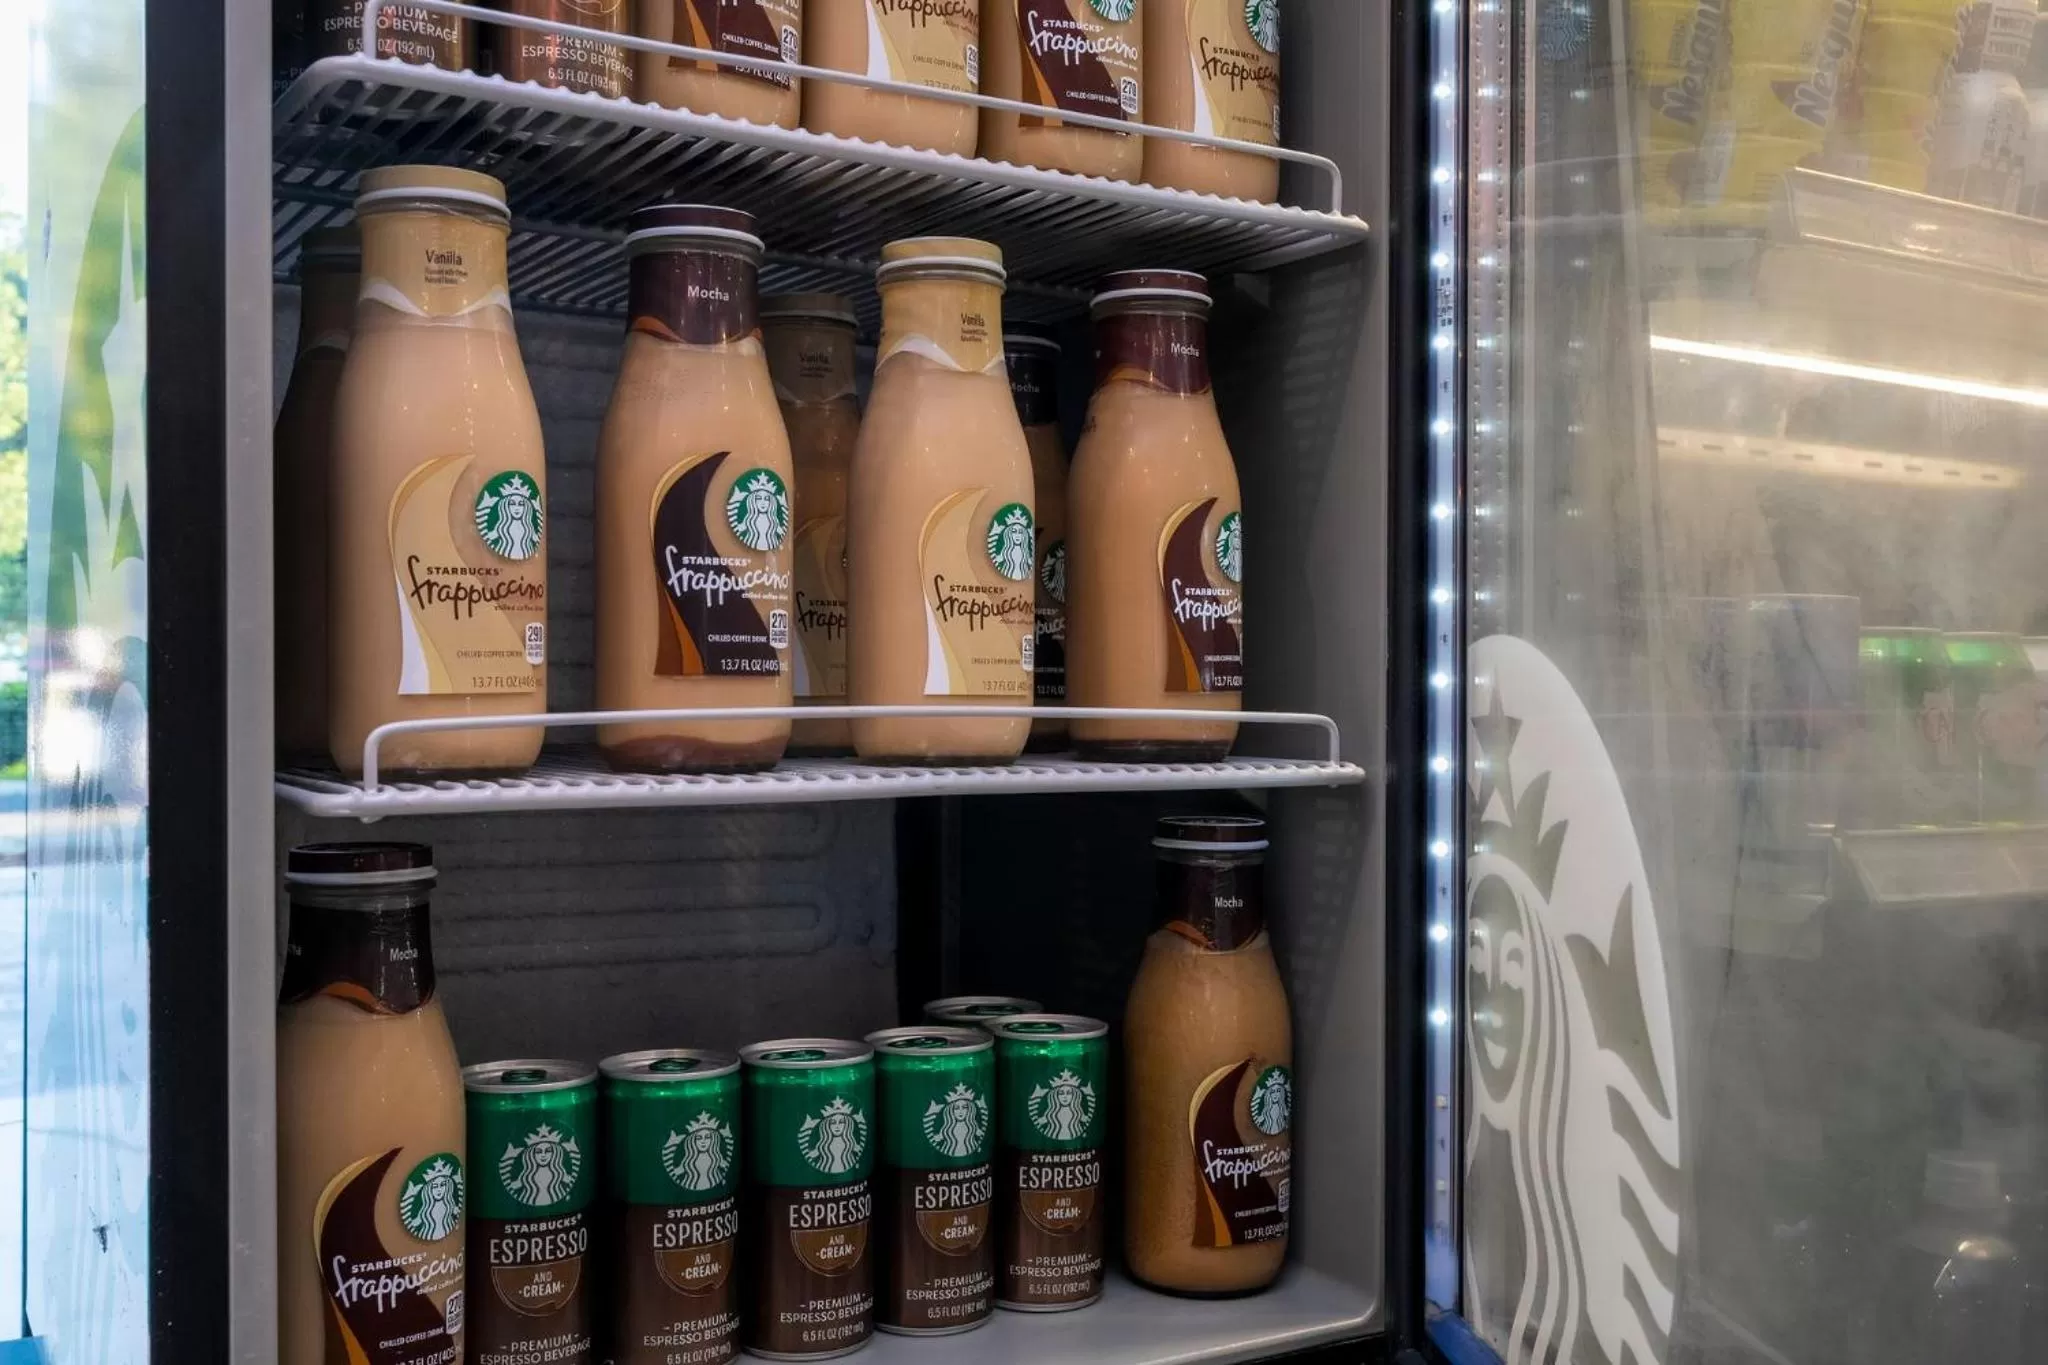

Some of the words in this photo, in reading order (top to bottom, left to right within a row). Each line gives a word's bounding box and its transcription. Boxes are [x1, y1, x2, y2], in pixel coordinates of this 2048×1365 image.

[355, 2, 428, 20] PMIUM
[325, 15, 389, 32] ESPREO
[393, 18, 458, 43] BEVERAGE
[1042, 19, 1102, 33] STARBUCKS
[556, 33, 618, 58] PREMIUM
[1028, 10, 1138, 66] frappuccino
[522, 45, 587, 62] ESPRESSO
[425, 249, 463, 266] Vanilla
[687, 285, 730, 302] Mocha
[682, 556, 747, 567] STARBUCKS
[426, 566, 500, 576] STARBUCKS
[665, 545, 789, 608] frappuccino
[407, 554, 544, 620] frappuccino
[950, 584, 1005, 595] STARBUCKS
[721, 658, 740, 671] 13.7
[472, 676, 492, 688] 13.7
[1214, 896, 1243, 908] Mocha
[389, 948, 418, 962] Mocha
[1032, 1153, 1092, 1163] STARBUCKS
[928, 1167, 985, 1182] STARBUCKS
[1019, 1162, 1100, 1189] ESPRESSO
[803, 1184, 864, 1200] STARBUCKS
[915, 1176, 993, 1209] ESPRESSO
[1056, 1197, 1071, 1206] AND
[668, 1202, 731, 1219] STARBUCKS
[790, 1193, 872, 1228] ESPRESSO
[504, 1216, 577, 1234] STARBUCKS
[953, 1215, 968, 1226] AND
[653, 1210, 738, 1248] ESPRESSO
[490, 1227, 588, 1264] ESPRESSO
[829, 1234, 845, 1246] AND
[351, 1253, 423, 1274] STARBUCKS
[694, 1253, 711, 1265] AND
[1036, 1253, 1087, 1266] PREMIUM
[534, 1271, 552, 1284] AND
[1009, 1264, 1061, 1277] ESPRESSO
[332, 1253, 464, 1313] frappuccino
[934, 1271, 983, 1289] PREMIUM
[809, 1292, 861, 1311] PREMIUM
[906, 1287, 960, 1301] ESPRESSO
[673, 1312, 727, 1333] PREMIUM
[780, 1310, 836, 1323] ESPRESSO
[511, 1333, 572, 1353] PREMIUM
[643, 1331, 702, 1347] ESPRESSO
[480, 1352, 542, 1365] ESPRESSO
